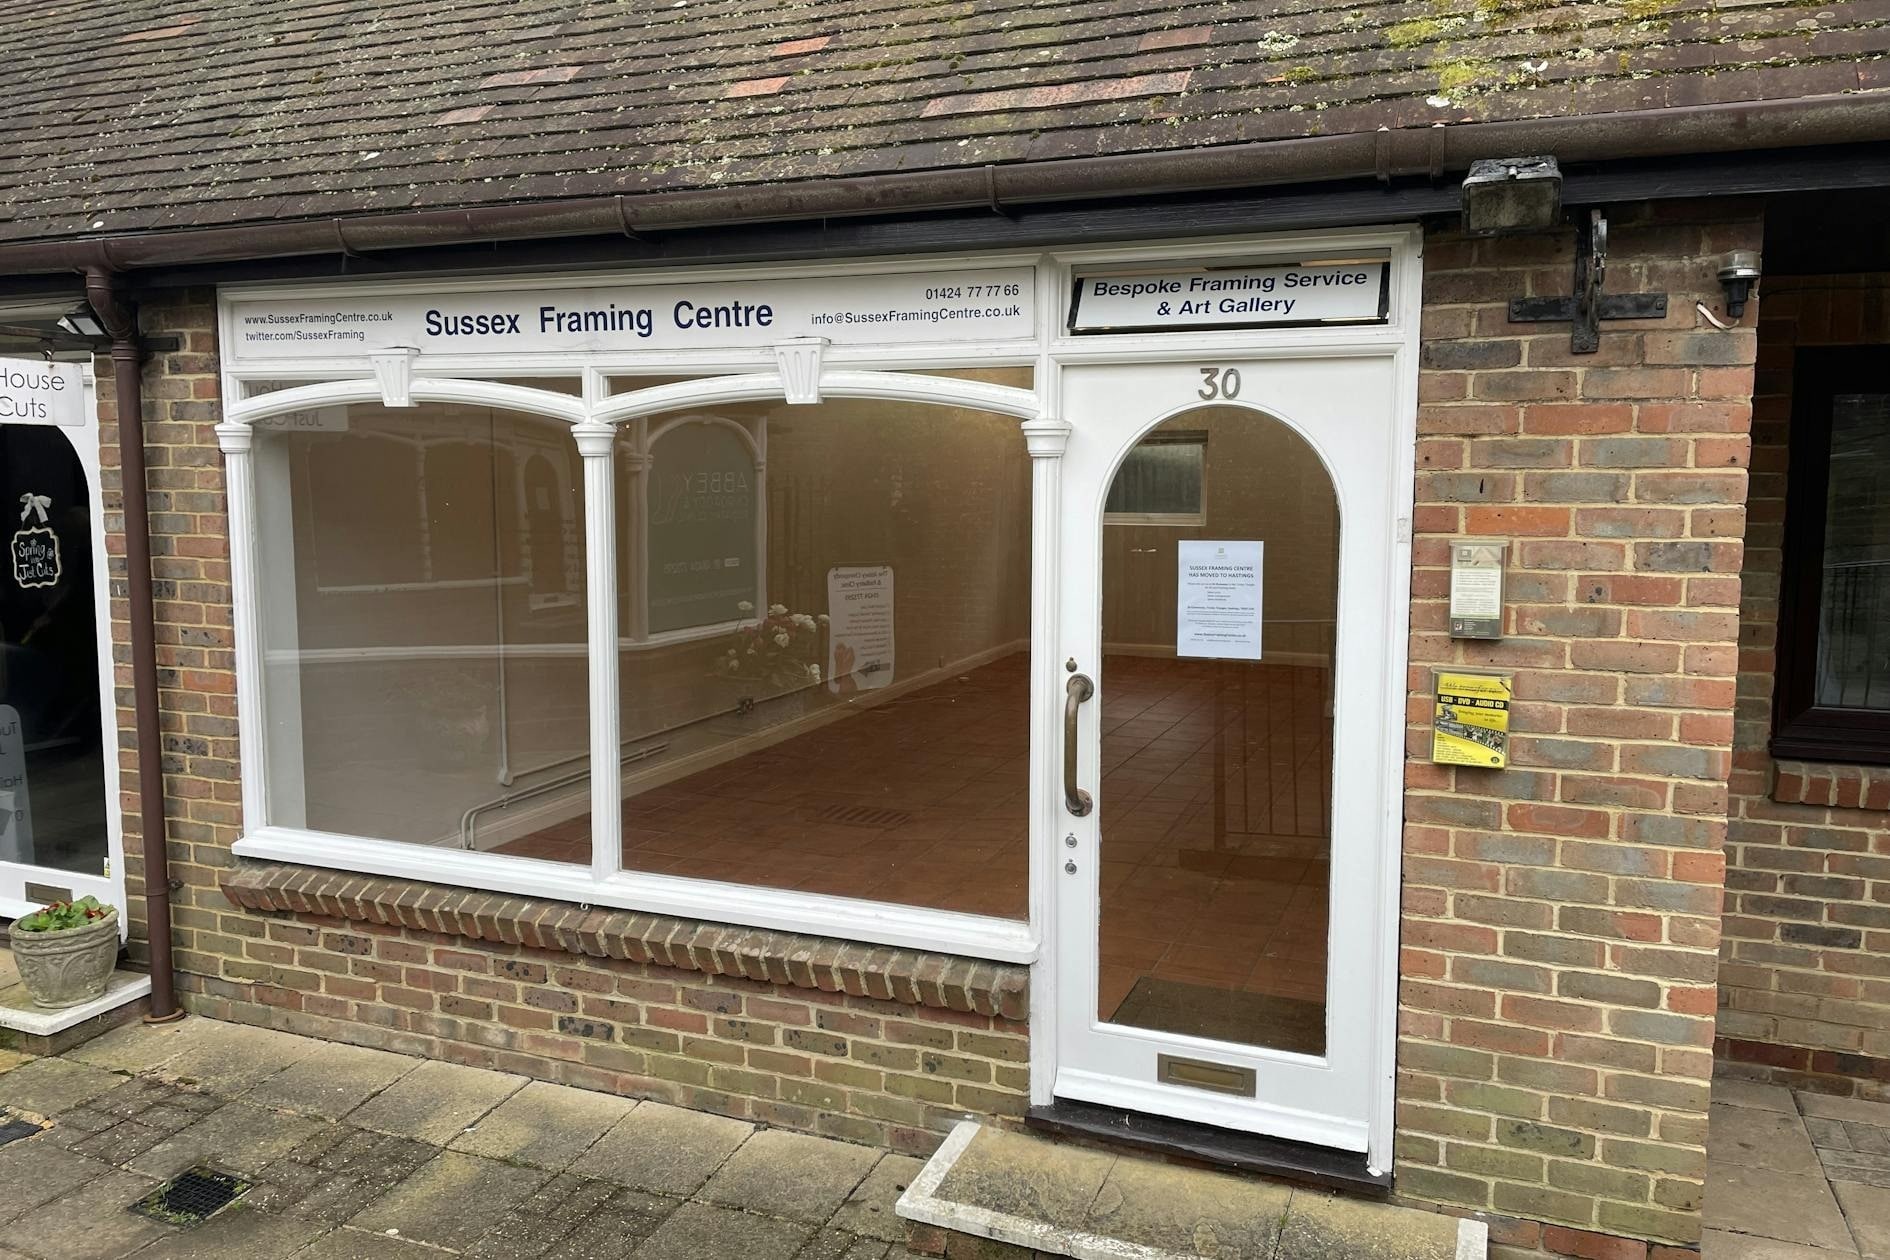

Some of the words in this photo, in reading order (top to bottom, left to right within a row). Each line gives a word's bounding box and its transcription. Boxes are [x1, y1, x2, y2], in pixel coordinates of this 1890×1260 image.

[925, 287, 962, 300] 01424
[1094, 279, 1181, 298] Bespoke
[1189, 274, 1276, 292] Framing
[1284, 270, 1368, 288] Service
[811, 304, 1020, 326] info@SussexFramingCentre.co.uk
[1157, 301, 1171, 316] &
[1179, 300, 1211, 315] Art
[1219, 297, 1296, 314] Gallery
[244, 311, 393, 325] www.SussexFramingCentre.co.uk
[425, 309, 520, 336] Sussex
[539, 303, 653, 338] Framing
[673, 300, 774, 330] Centre
[245, 329, 366, 342] twitter.com/SussexFraming
[1198, 367, 1241, 400] 30
[1457, 697, 1471, 705] DVD
[1475, 699, 1494, 708] AUDIO
